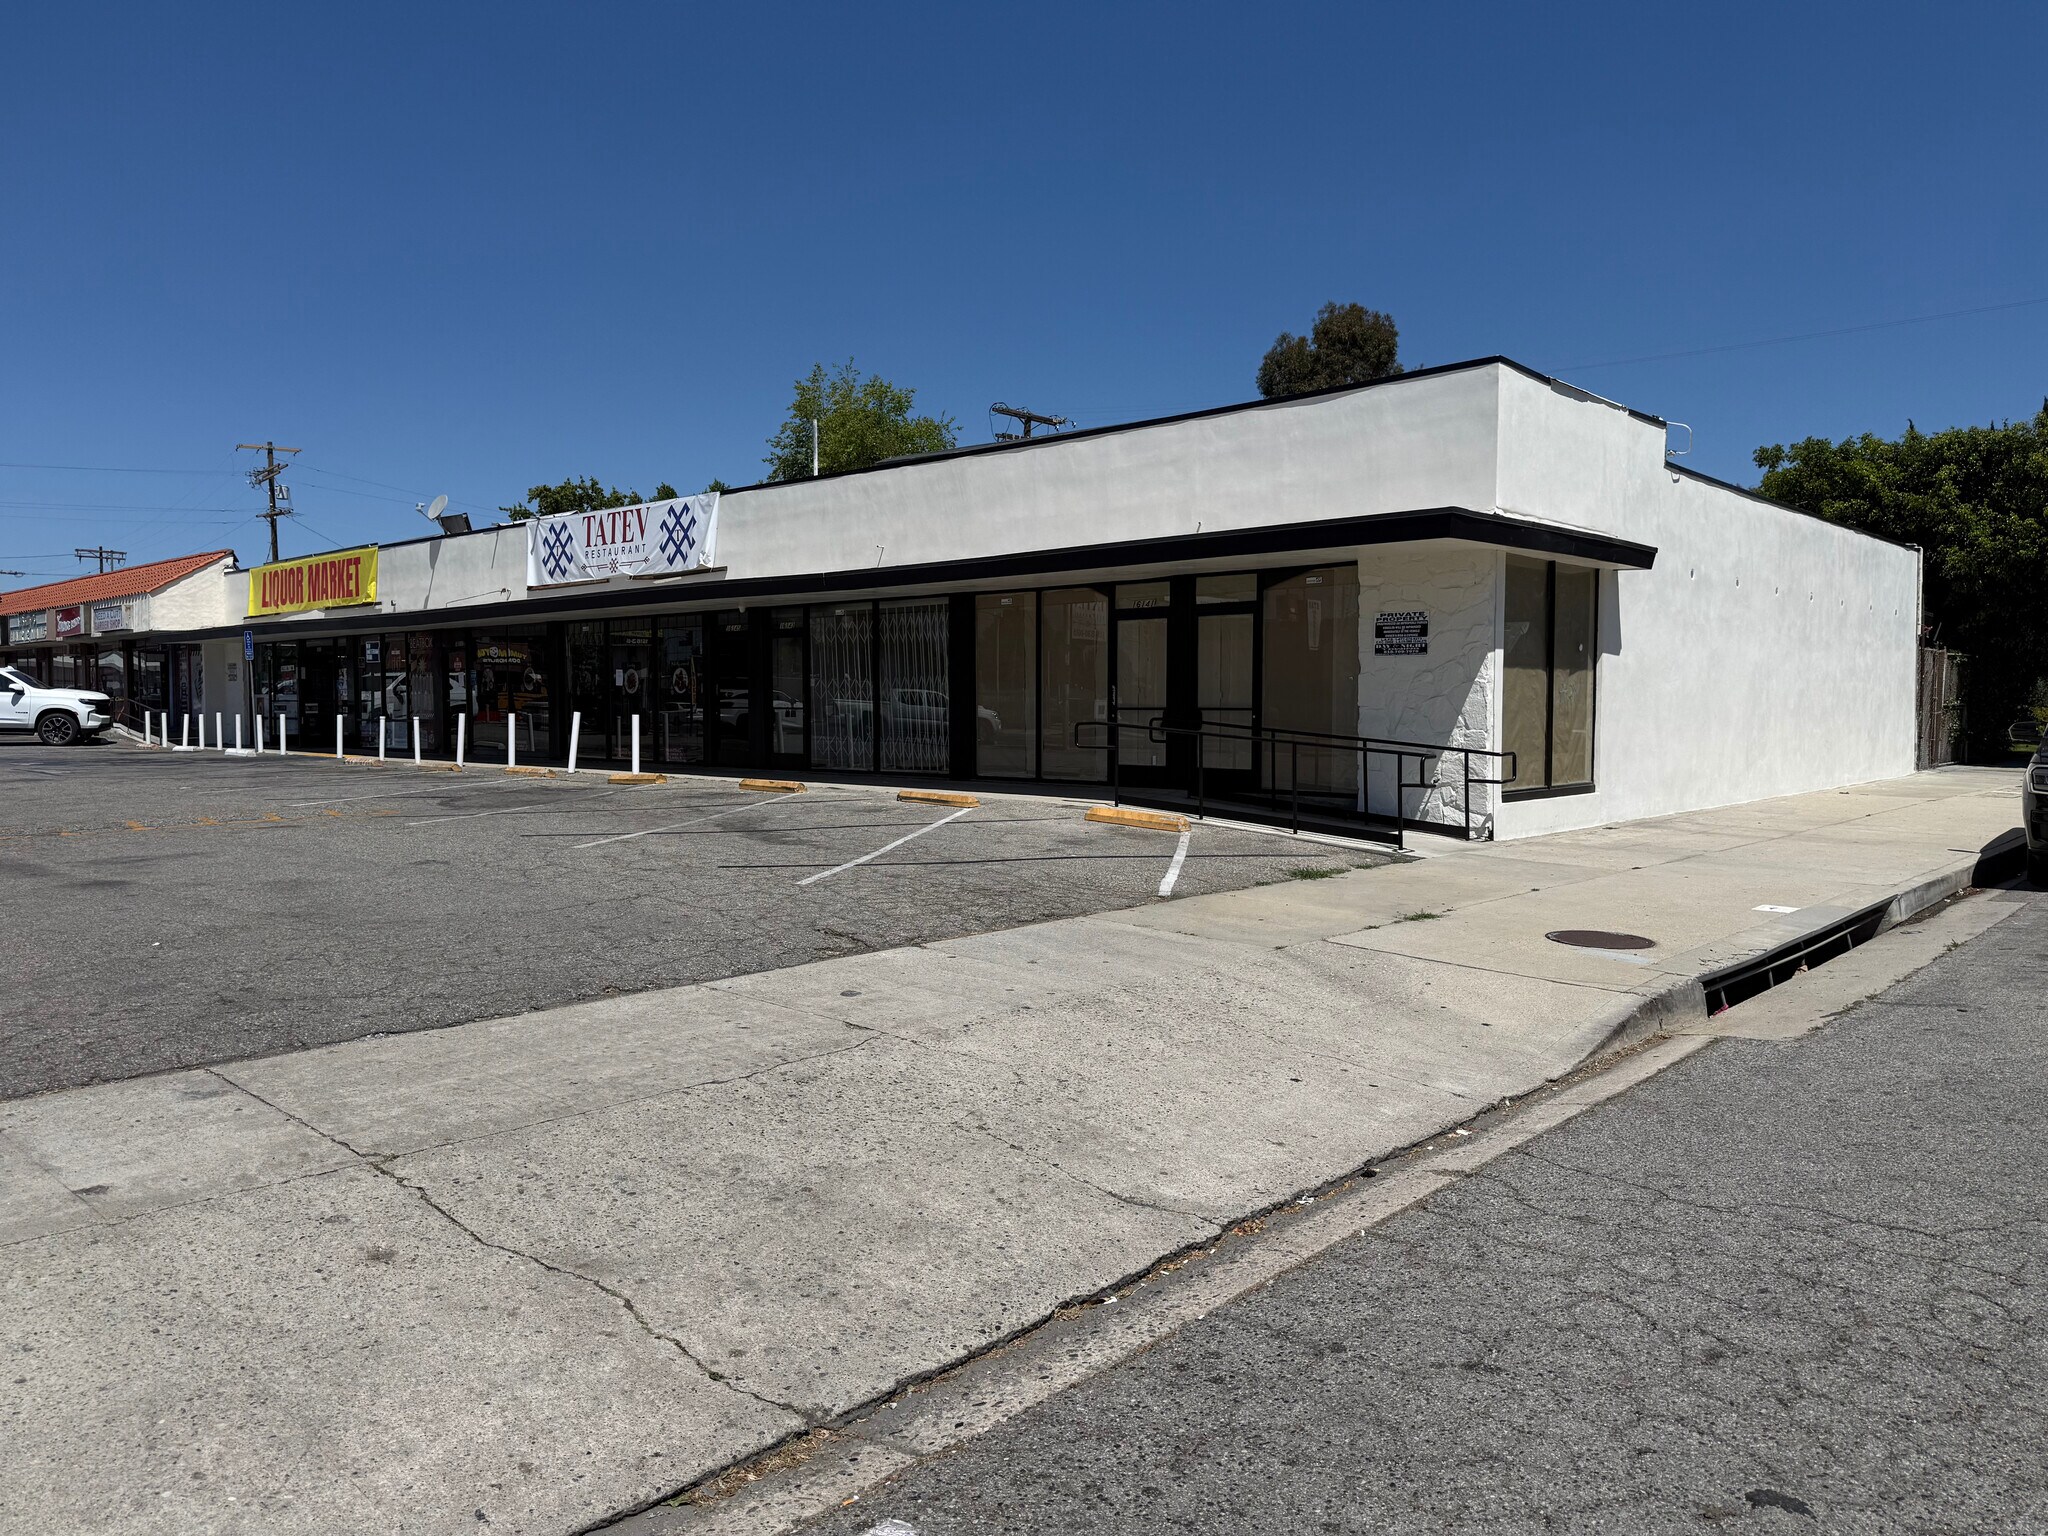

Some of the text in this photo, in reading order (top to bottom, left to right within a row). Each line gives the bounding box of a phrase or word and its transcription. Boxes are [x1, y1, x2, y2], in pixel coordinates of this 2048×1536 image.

[582, 507, 651, 548] TATEV
[585, 543, 647, 560] RESTAURANT
[261, 556, 361, 609] LIQUOR MARKET
